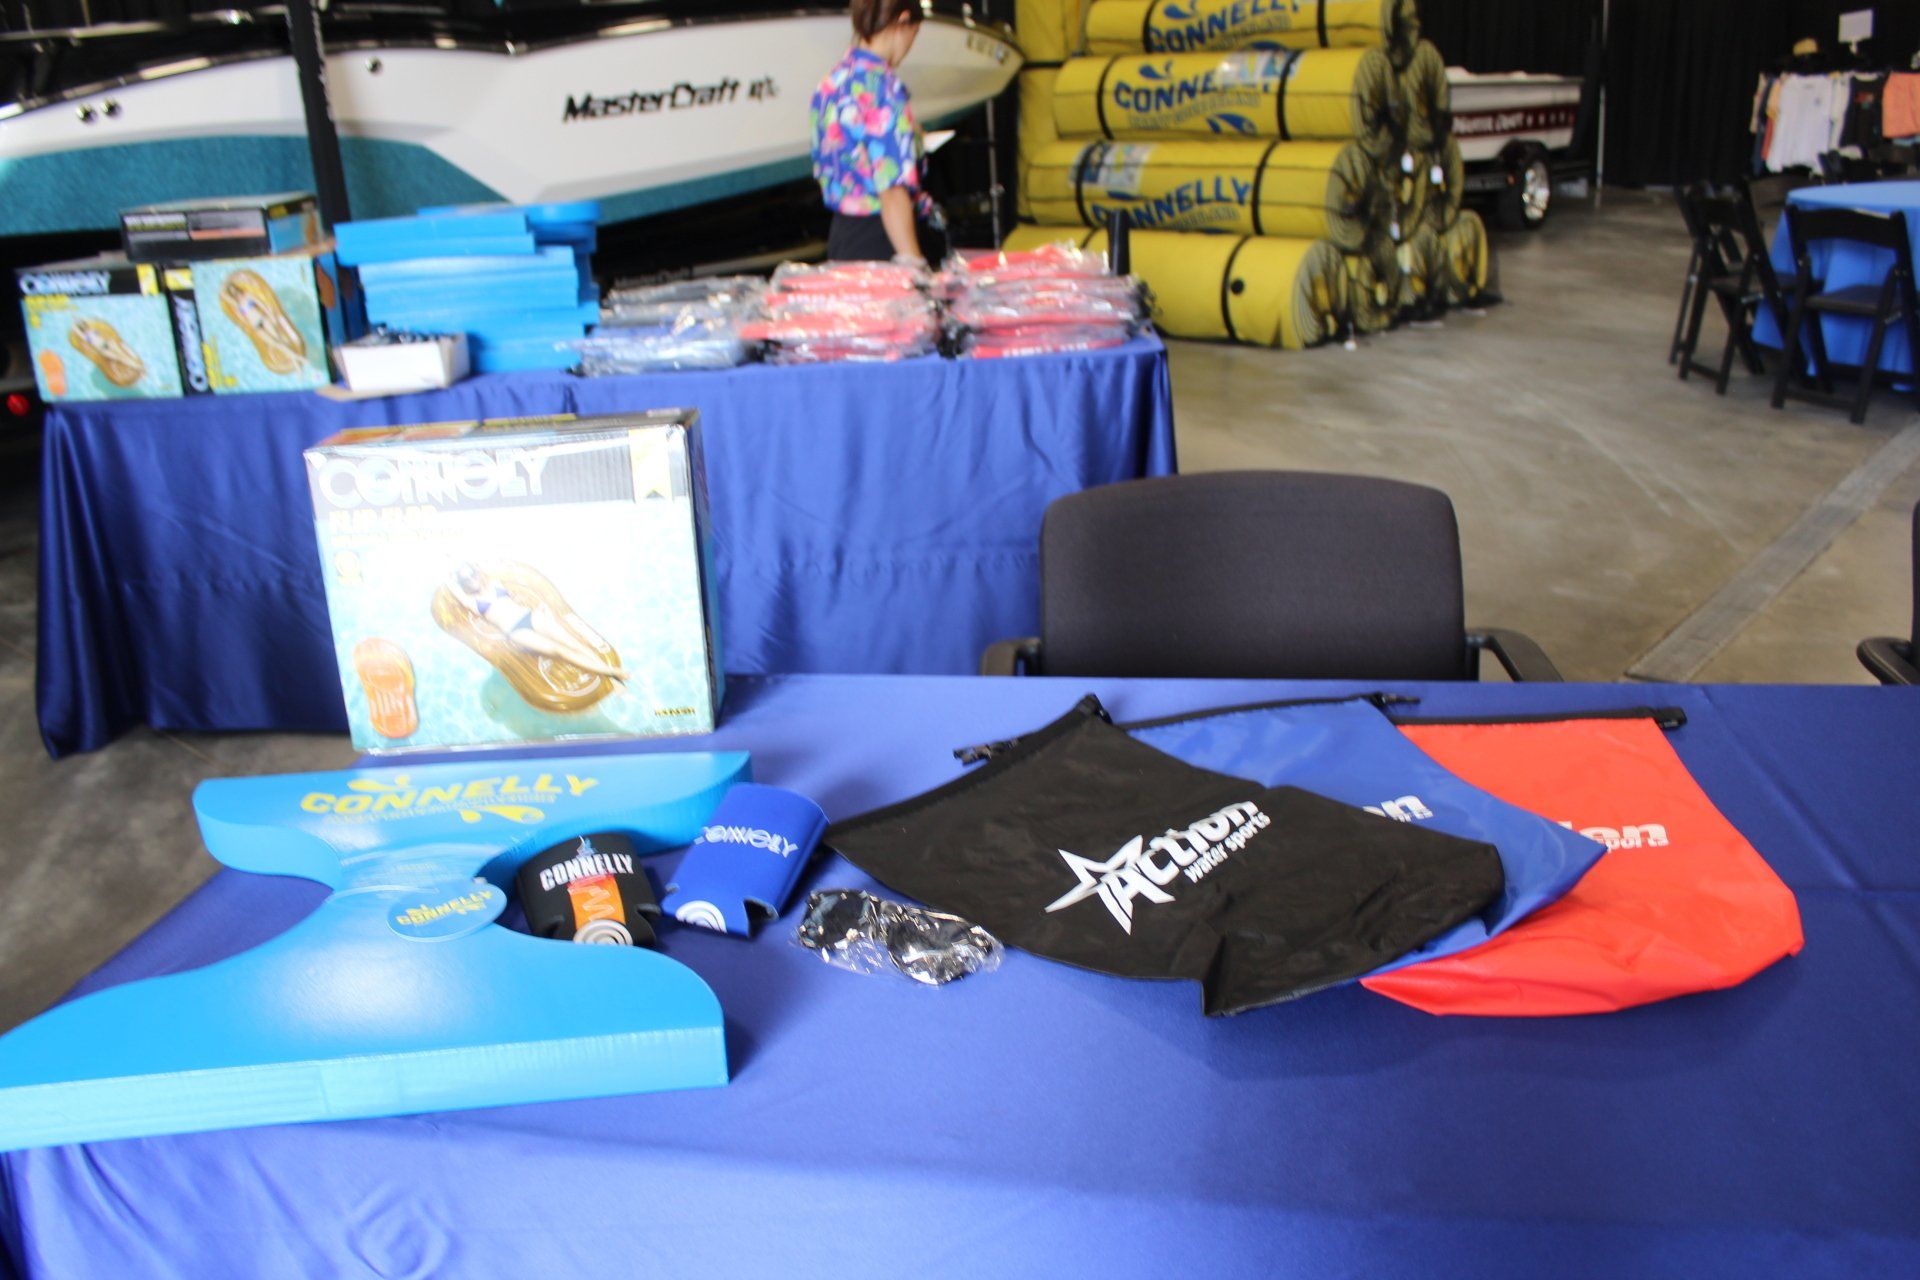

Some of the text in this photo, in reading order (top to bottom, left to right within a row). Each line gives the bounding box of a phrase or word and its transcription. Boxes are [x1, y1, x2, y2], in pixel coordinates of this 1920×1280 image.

[562, 75, 740, 123] MasterCraft
[300, 773, 599, 814] CONNELLY
[1184, 811, 1272, 884] water sports
[539, 853, 634, 892] CONNELLY
